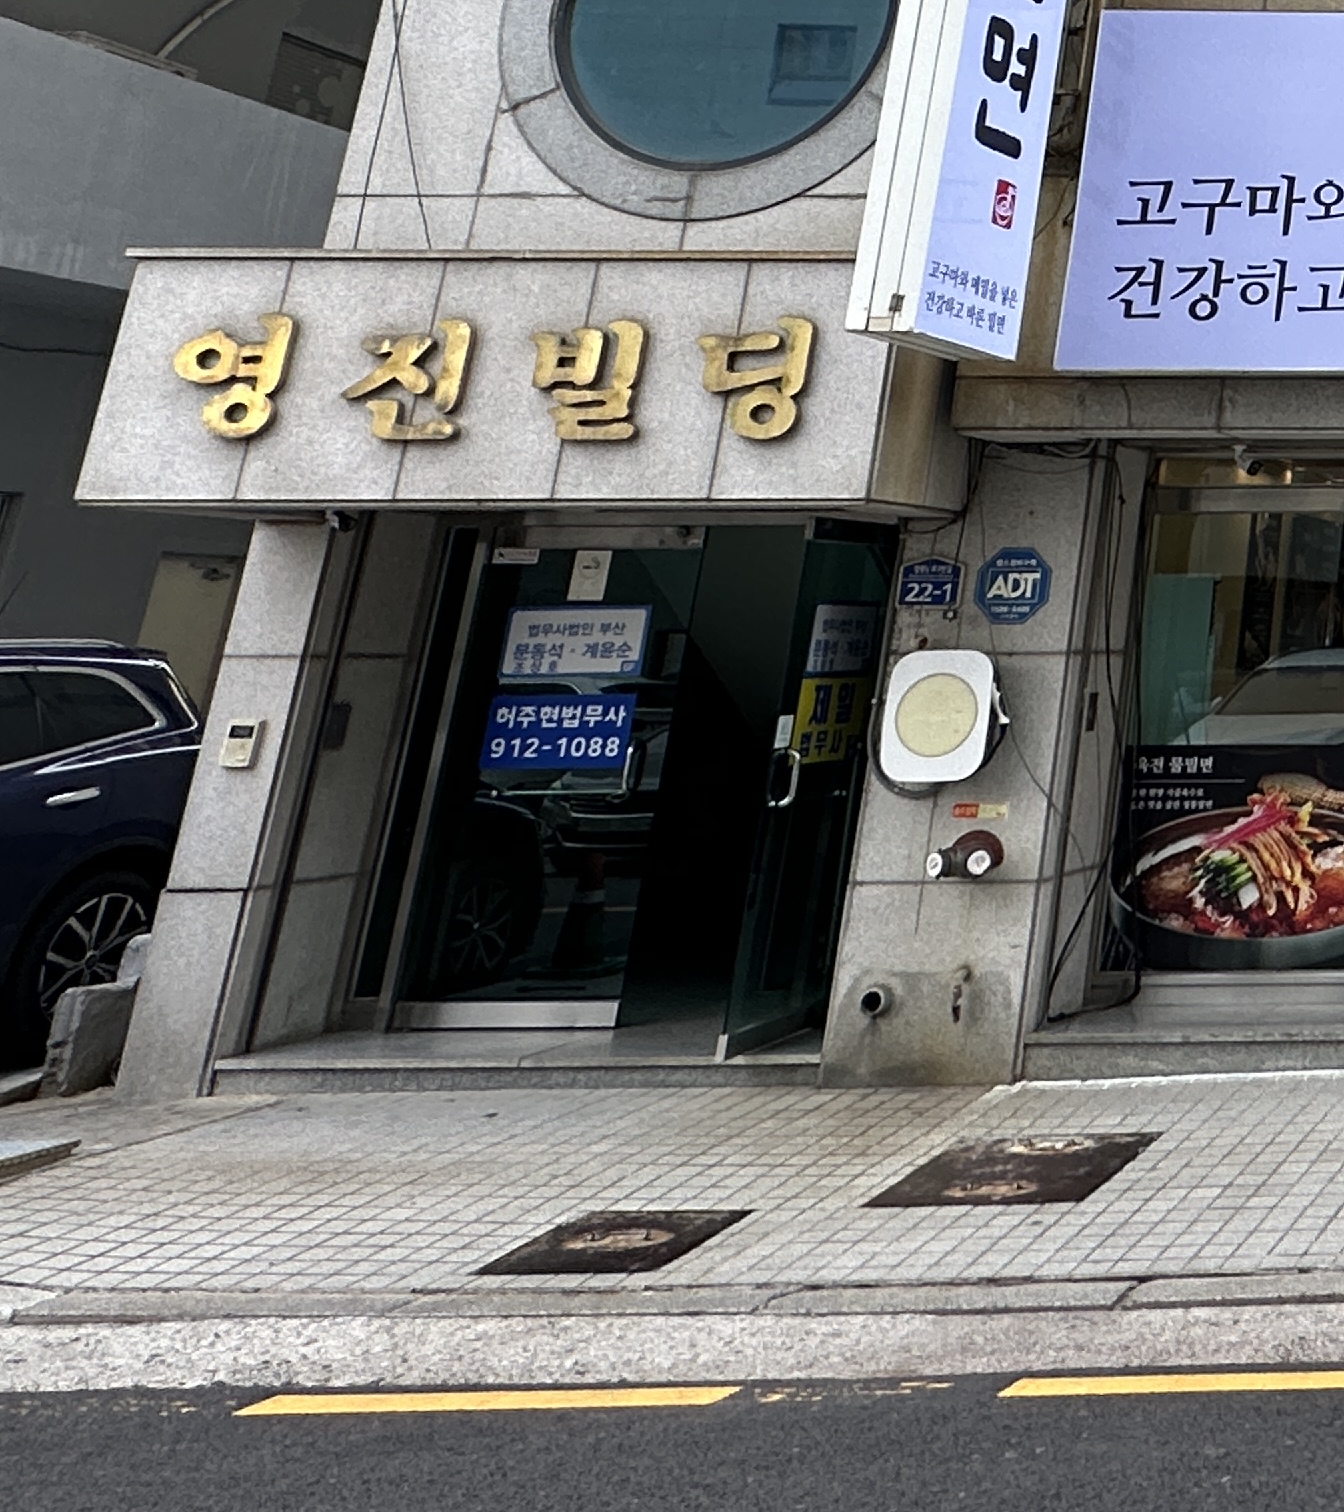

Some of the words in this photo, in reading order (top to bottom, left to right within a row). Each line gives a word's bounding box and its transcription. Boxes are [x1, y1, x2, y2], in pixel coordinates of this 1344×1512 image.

[928, 260, 969, 292] 고구마와
[925, 291, 964, 319] 건강하고
[904, 582, 953, 603] 22-1
[986, 572, 1042, 599] ADT
[528, 622, 594, 638] 법무사법인
[599, 621, 627, 637] 부산
[490, 737, 620, 759] 912-1088
